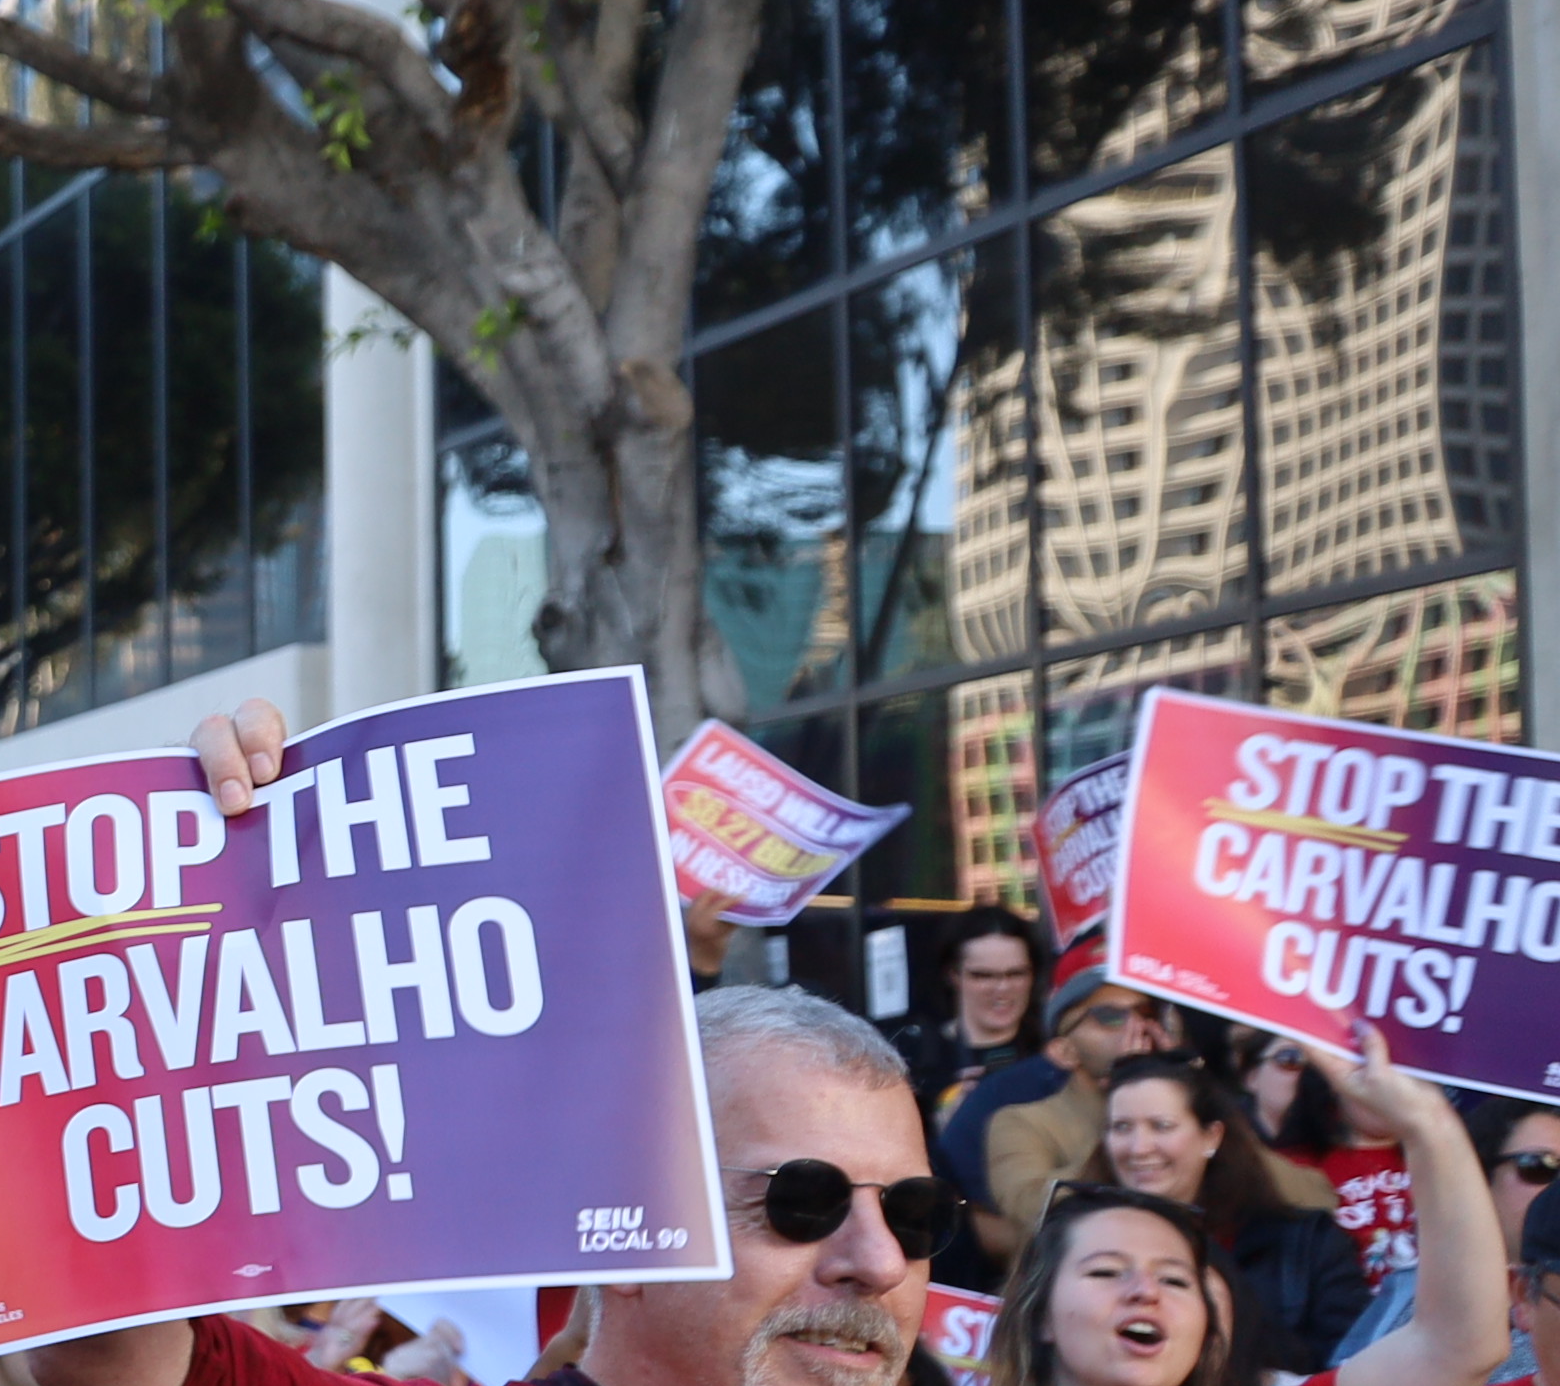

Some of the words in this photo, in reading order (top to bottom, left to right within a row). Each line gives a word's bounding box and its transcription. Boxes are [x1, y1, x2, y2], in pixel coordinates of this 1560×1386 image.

[258, 731, 491, 888] THE
[1228, 732, 1427, 832] STOP
[1432, 762, 1560, 860] THE
[1193, 820, 1560, 963] CARVALHO
[1262, 919, 1479, 1035] CUTS!
[62, 1062, 413, 1243] CUTS!
[577, 1206, 644, 1232] SEIU
[579, 1229, 655, 1253] LOCAL
[657, 1227, 688, 1250] 99
